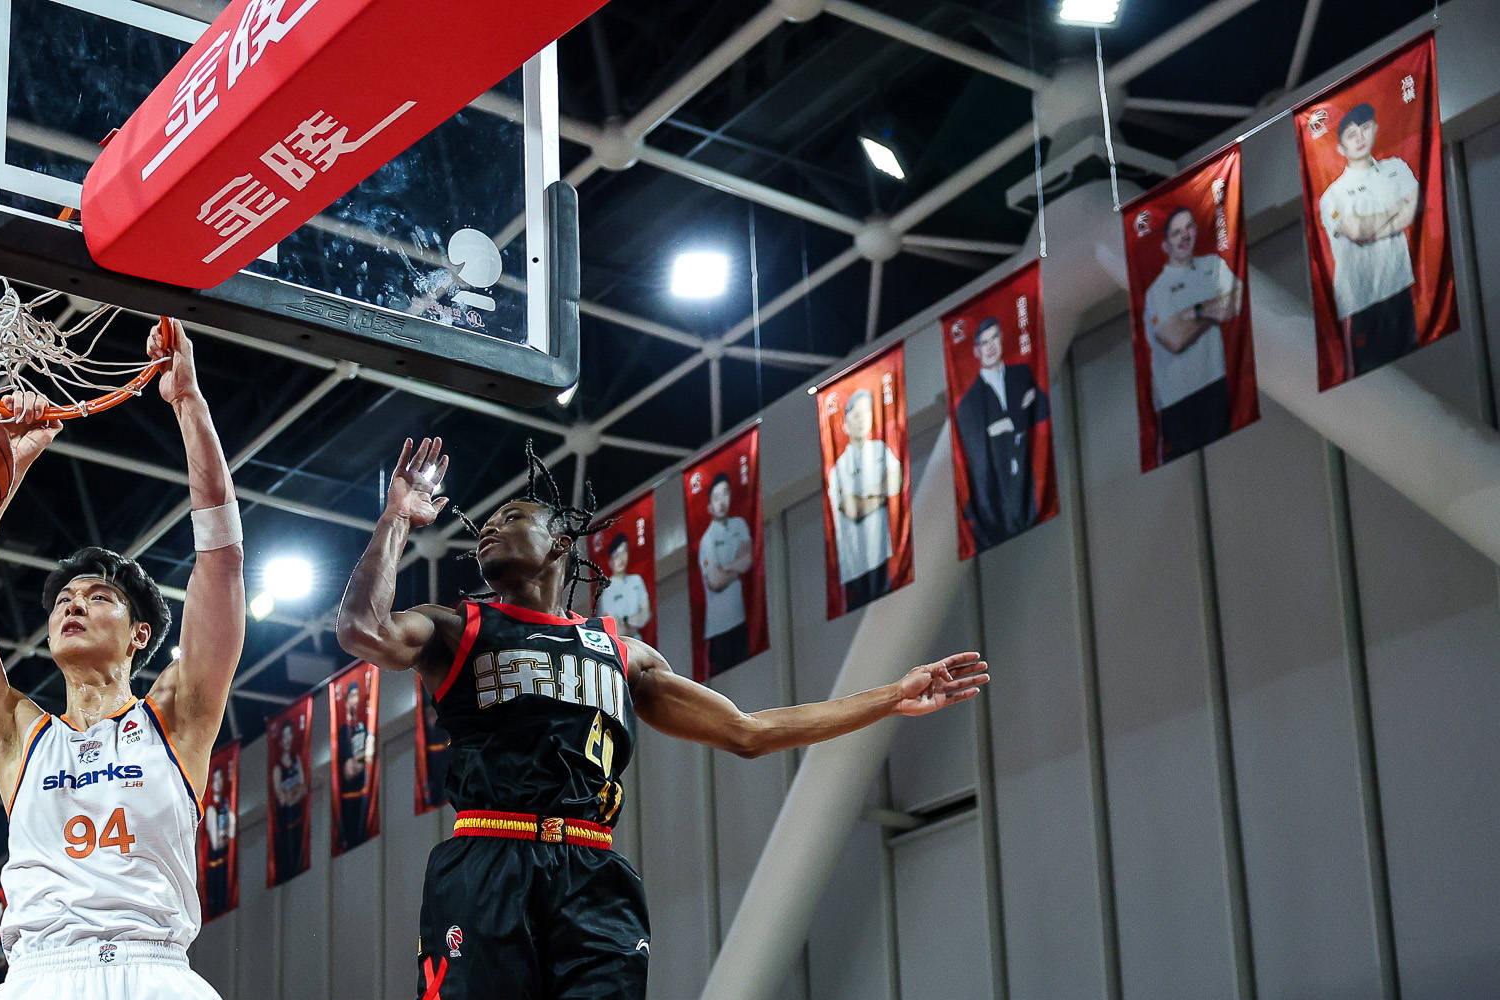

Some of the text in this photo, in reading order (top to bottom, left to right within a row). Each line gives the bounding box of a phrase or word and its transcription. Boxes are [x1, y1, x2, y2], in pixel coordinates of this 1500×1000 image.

[196, 100, 418, 264] 金陵
[43, 762, 143, 790] sharks
[63, 807, 136, 859] 94
